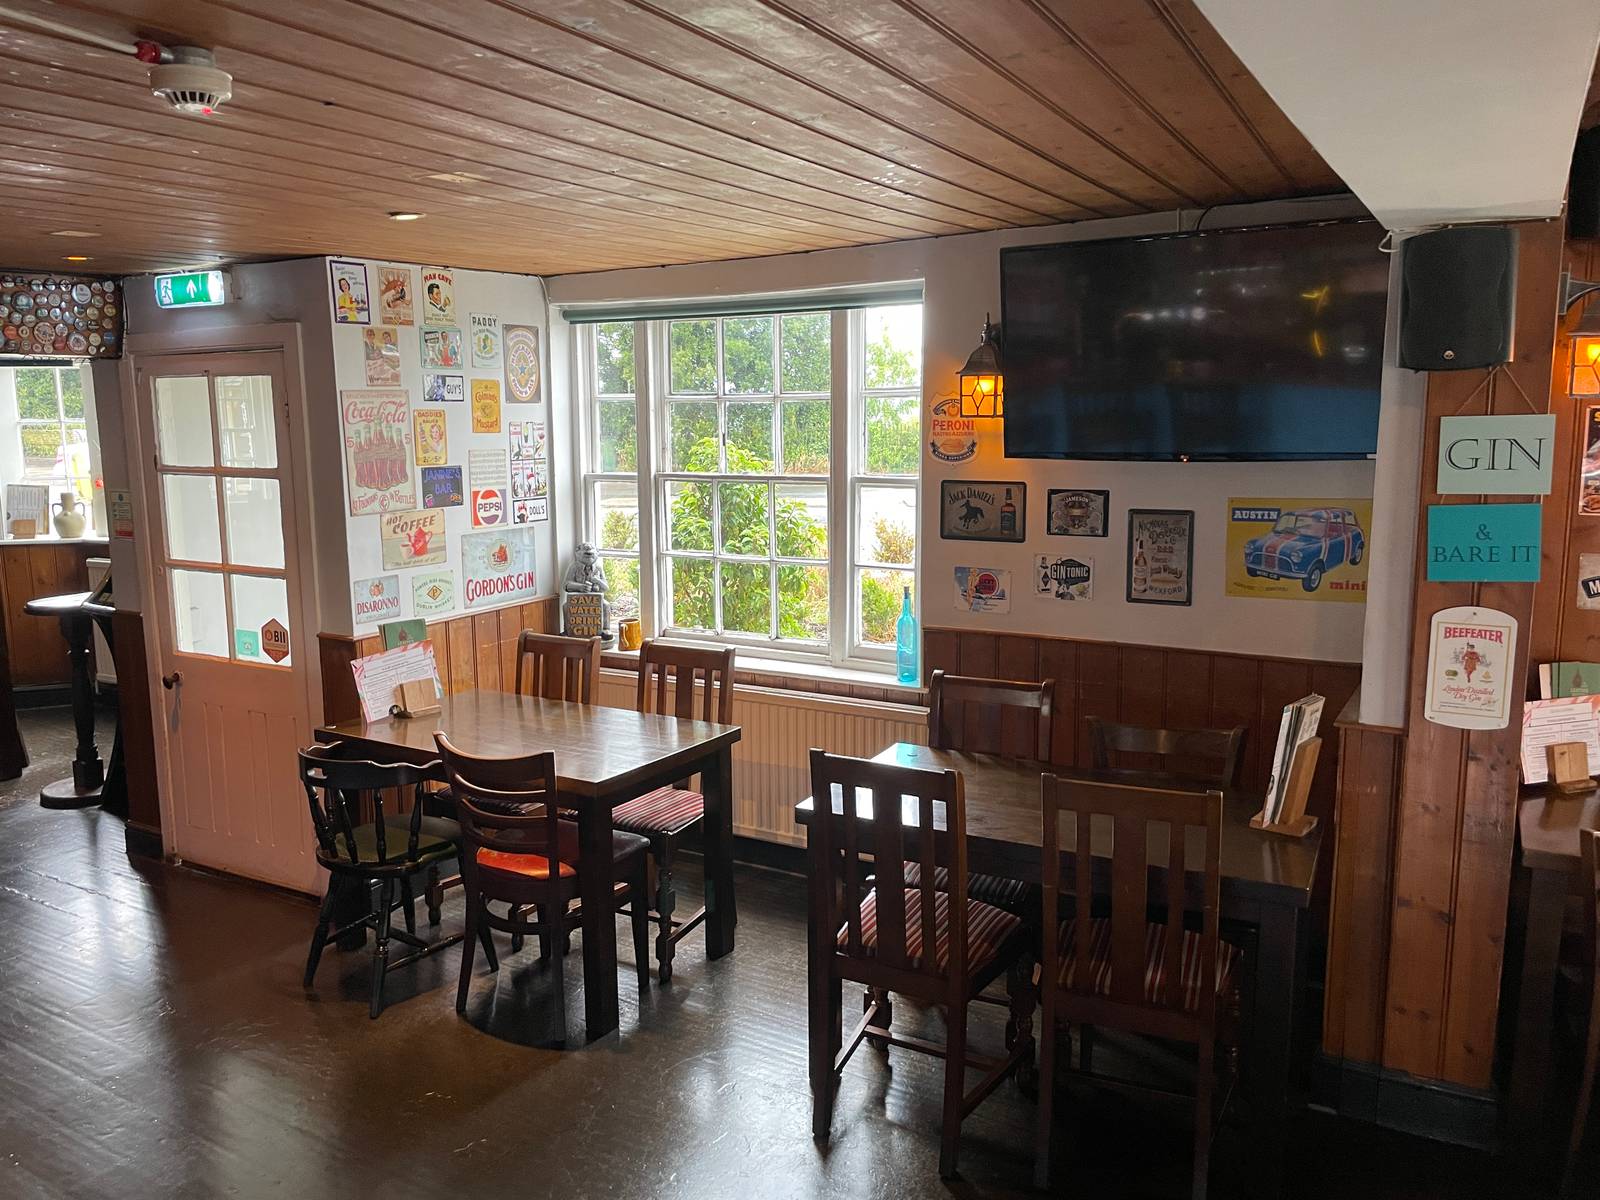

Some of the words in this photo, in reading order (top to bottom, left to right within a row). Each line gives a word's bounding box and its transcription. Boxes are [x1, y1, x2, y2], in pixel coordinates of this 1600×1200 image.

[472, 316, 497, 327] PADDY
[447, 384, 462, 394] GUY'S
[477, 417, 499, 429] Mustard
[933, 419, 975, 431] PERONI
[1445, 437, 1548, 471] GIN
[435, 483, 453, 495] BAR
[949, 490, 966, 505] JACK
[1065, 495, 1089, 503] JAMESON
[477, 501, 503, 512] PEPSI
[529, 504, 545, 516] DOLL'S
[1233, 509, 1278, 519] AUSTIN
[386, 515, 404, 526] HOT
[392, 514, 436, 534] COFFEE
[1475, 523, 1492, 541] &
[1433, 546, 1501, 563] BARE
[1511, 545, 1537, 562] IT
[1051, 564, 1066, 579] GIN
[1067, 566, 1089, 578] TONIC
[466, 574, 516, 604] GORDON'S
[516, 571, 534, 590] GIN
[1329, 580, 1367, 591] mini
[356, 596, 400, 615] DISARONNO
[571, 595, 599, 605] SAVE
[570, 606, 602, 615] WATER
[570, 616, 601, 625] DRINK
[573, 625, 597, 636] GIN
[1443, 626, 1504, 644] BEEFEATER
